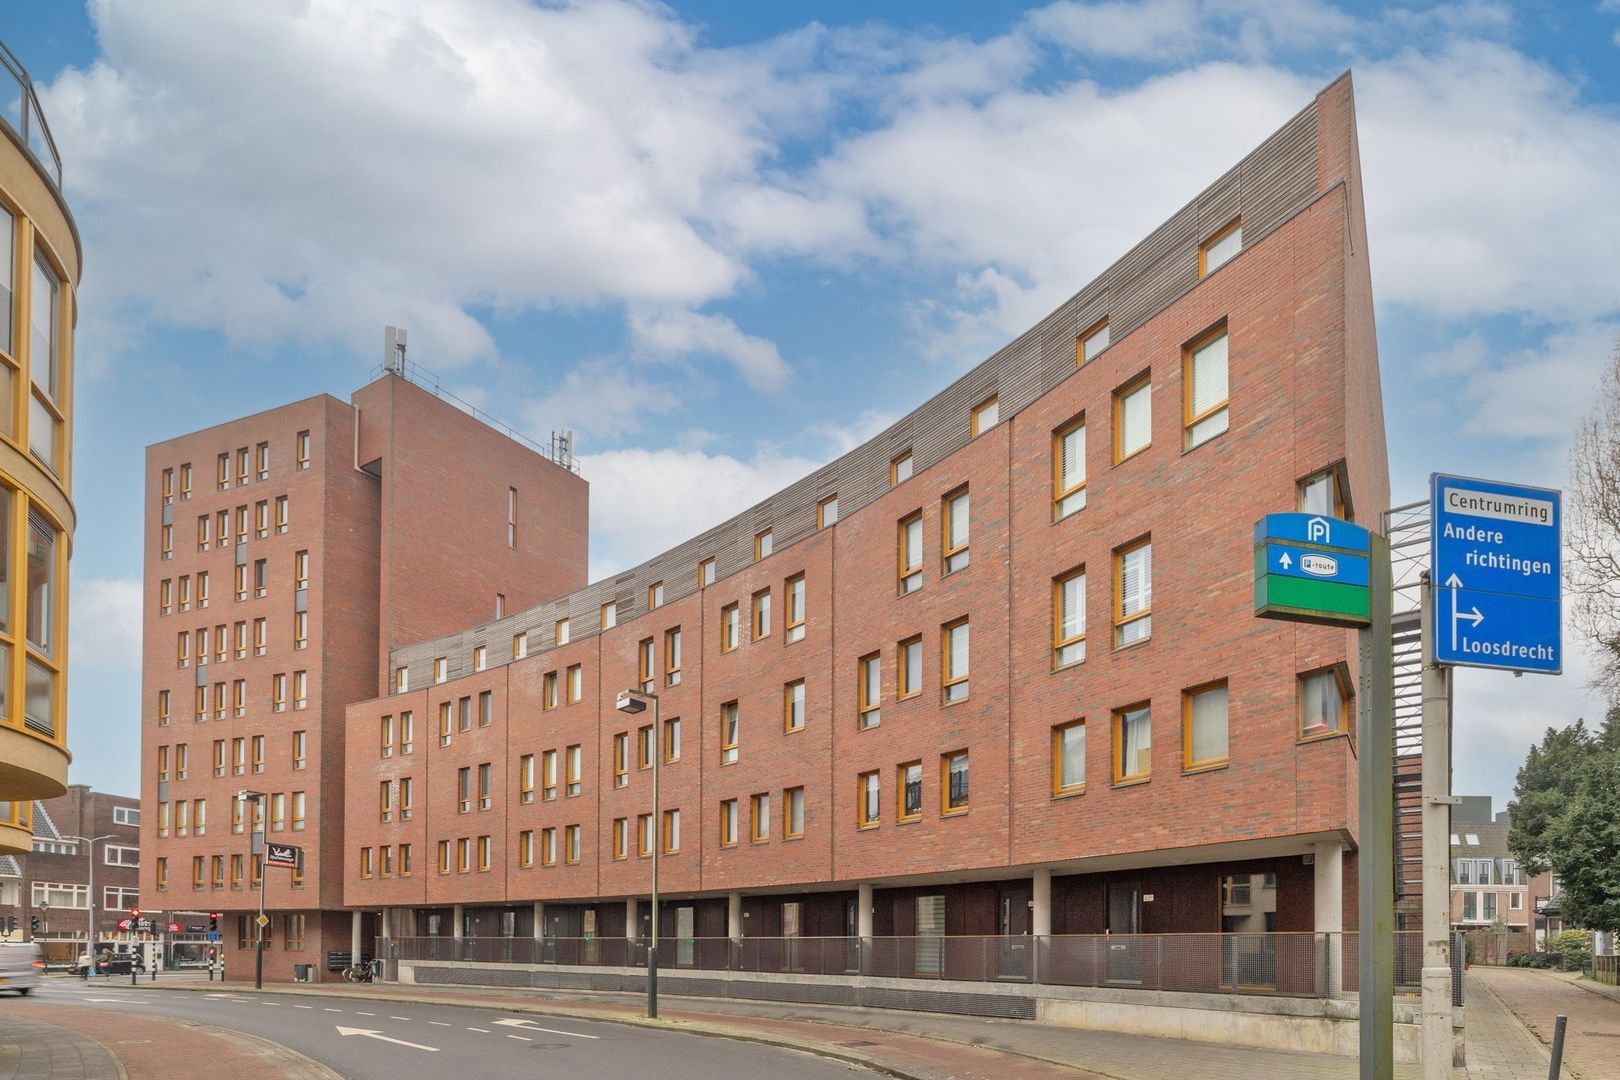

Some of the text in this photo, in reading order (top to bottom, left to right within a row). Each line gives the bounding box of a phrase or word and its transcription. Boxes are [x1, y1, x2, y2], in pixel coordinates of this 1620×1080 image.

[1449, 493, 1548, 522] Centrumring
[1443, 522, 1504, 544] Andere
[1466, 550, 1551, 576] richtingen
[1462, 636, 1554, 661] Loosdrecht
